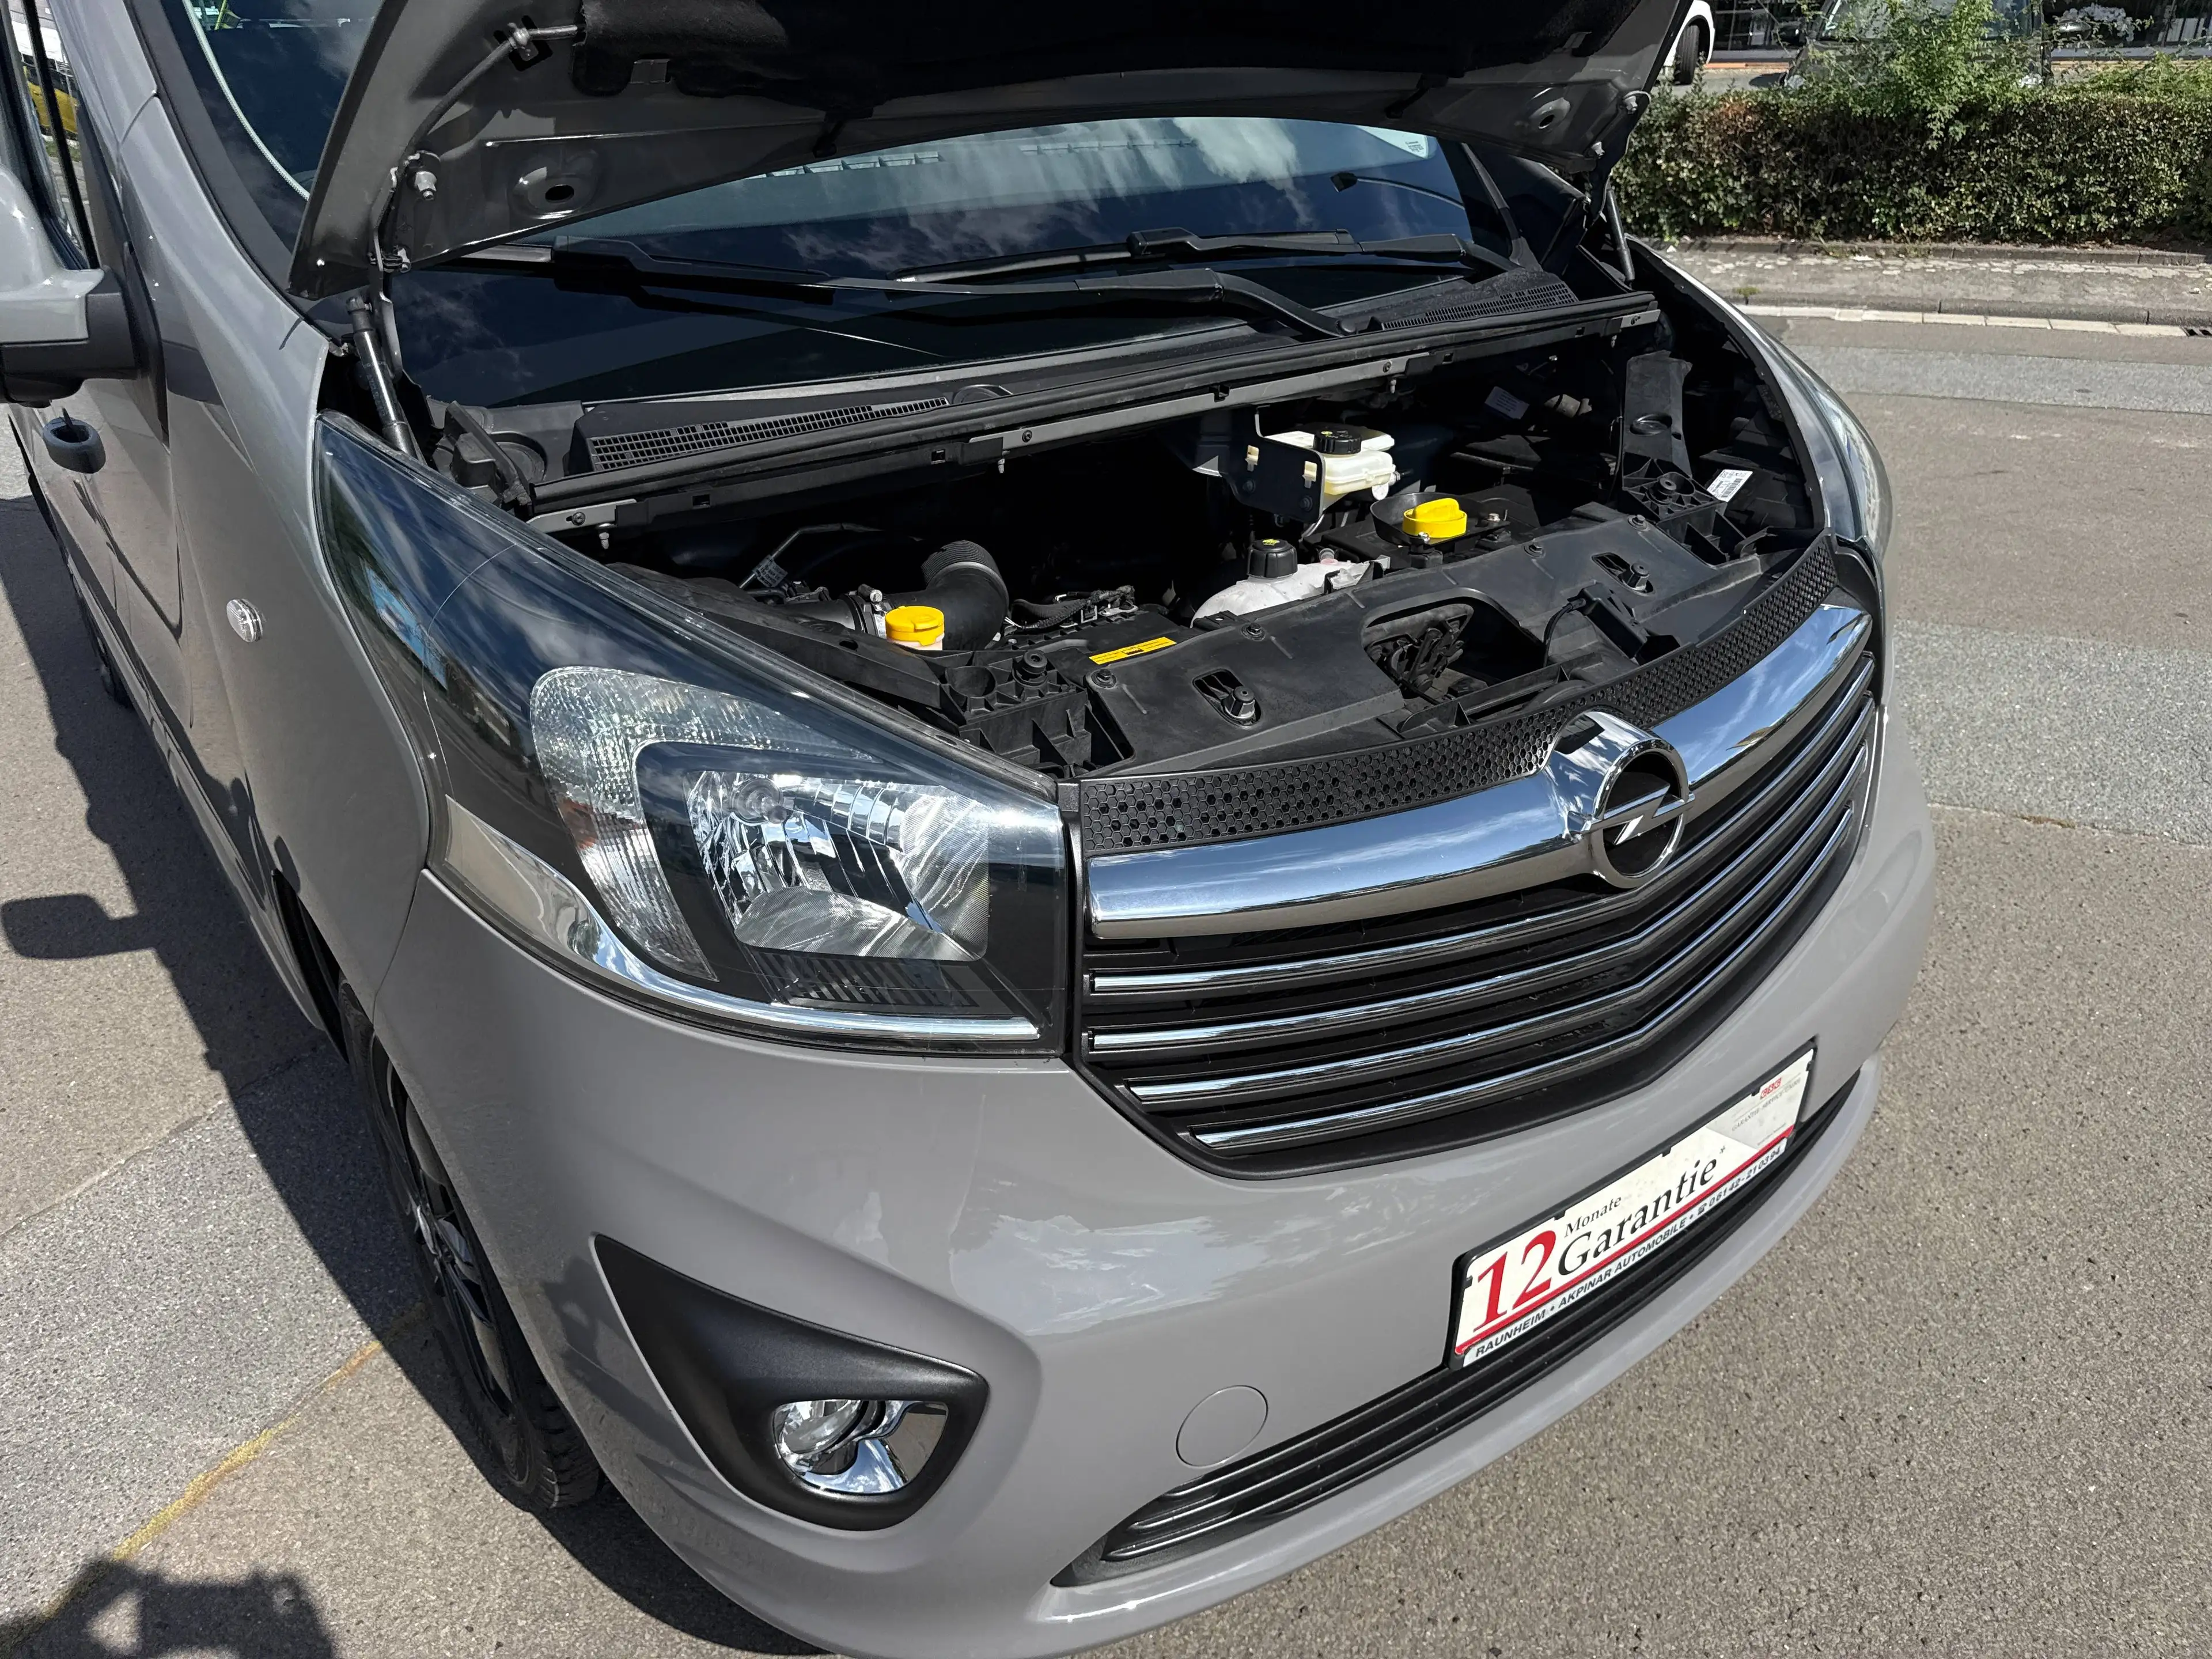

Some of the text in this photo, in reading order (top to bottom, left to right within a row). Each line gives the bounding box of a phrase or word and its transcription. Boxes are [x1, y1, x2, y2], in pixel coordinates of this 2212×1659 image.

[1563, 1196, 1622, 1238] Monate
[1472, 1230, 1556, 1333] 12
[1475, 1309, 1546, 1358] RAUNHEIM
[1558, 1268, 1612, 1309] AKPINAR
[1613, 1217, 1687, 1273] AUTOMOBILE
